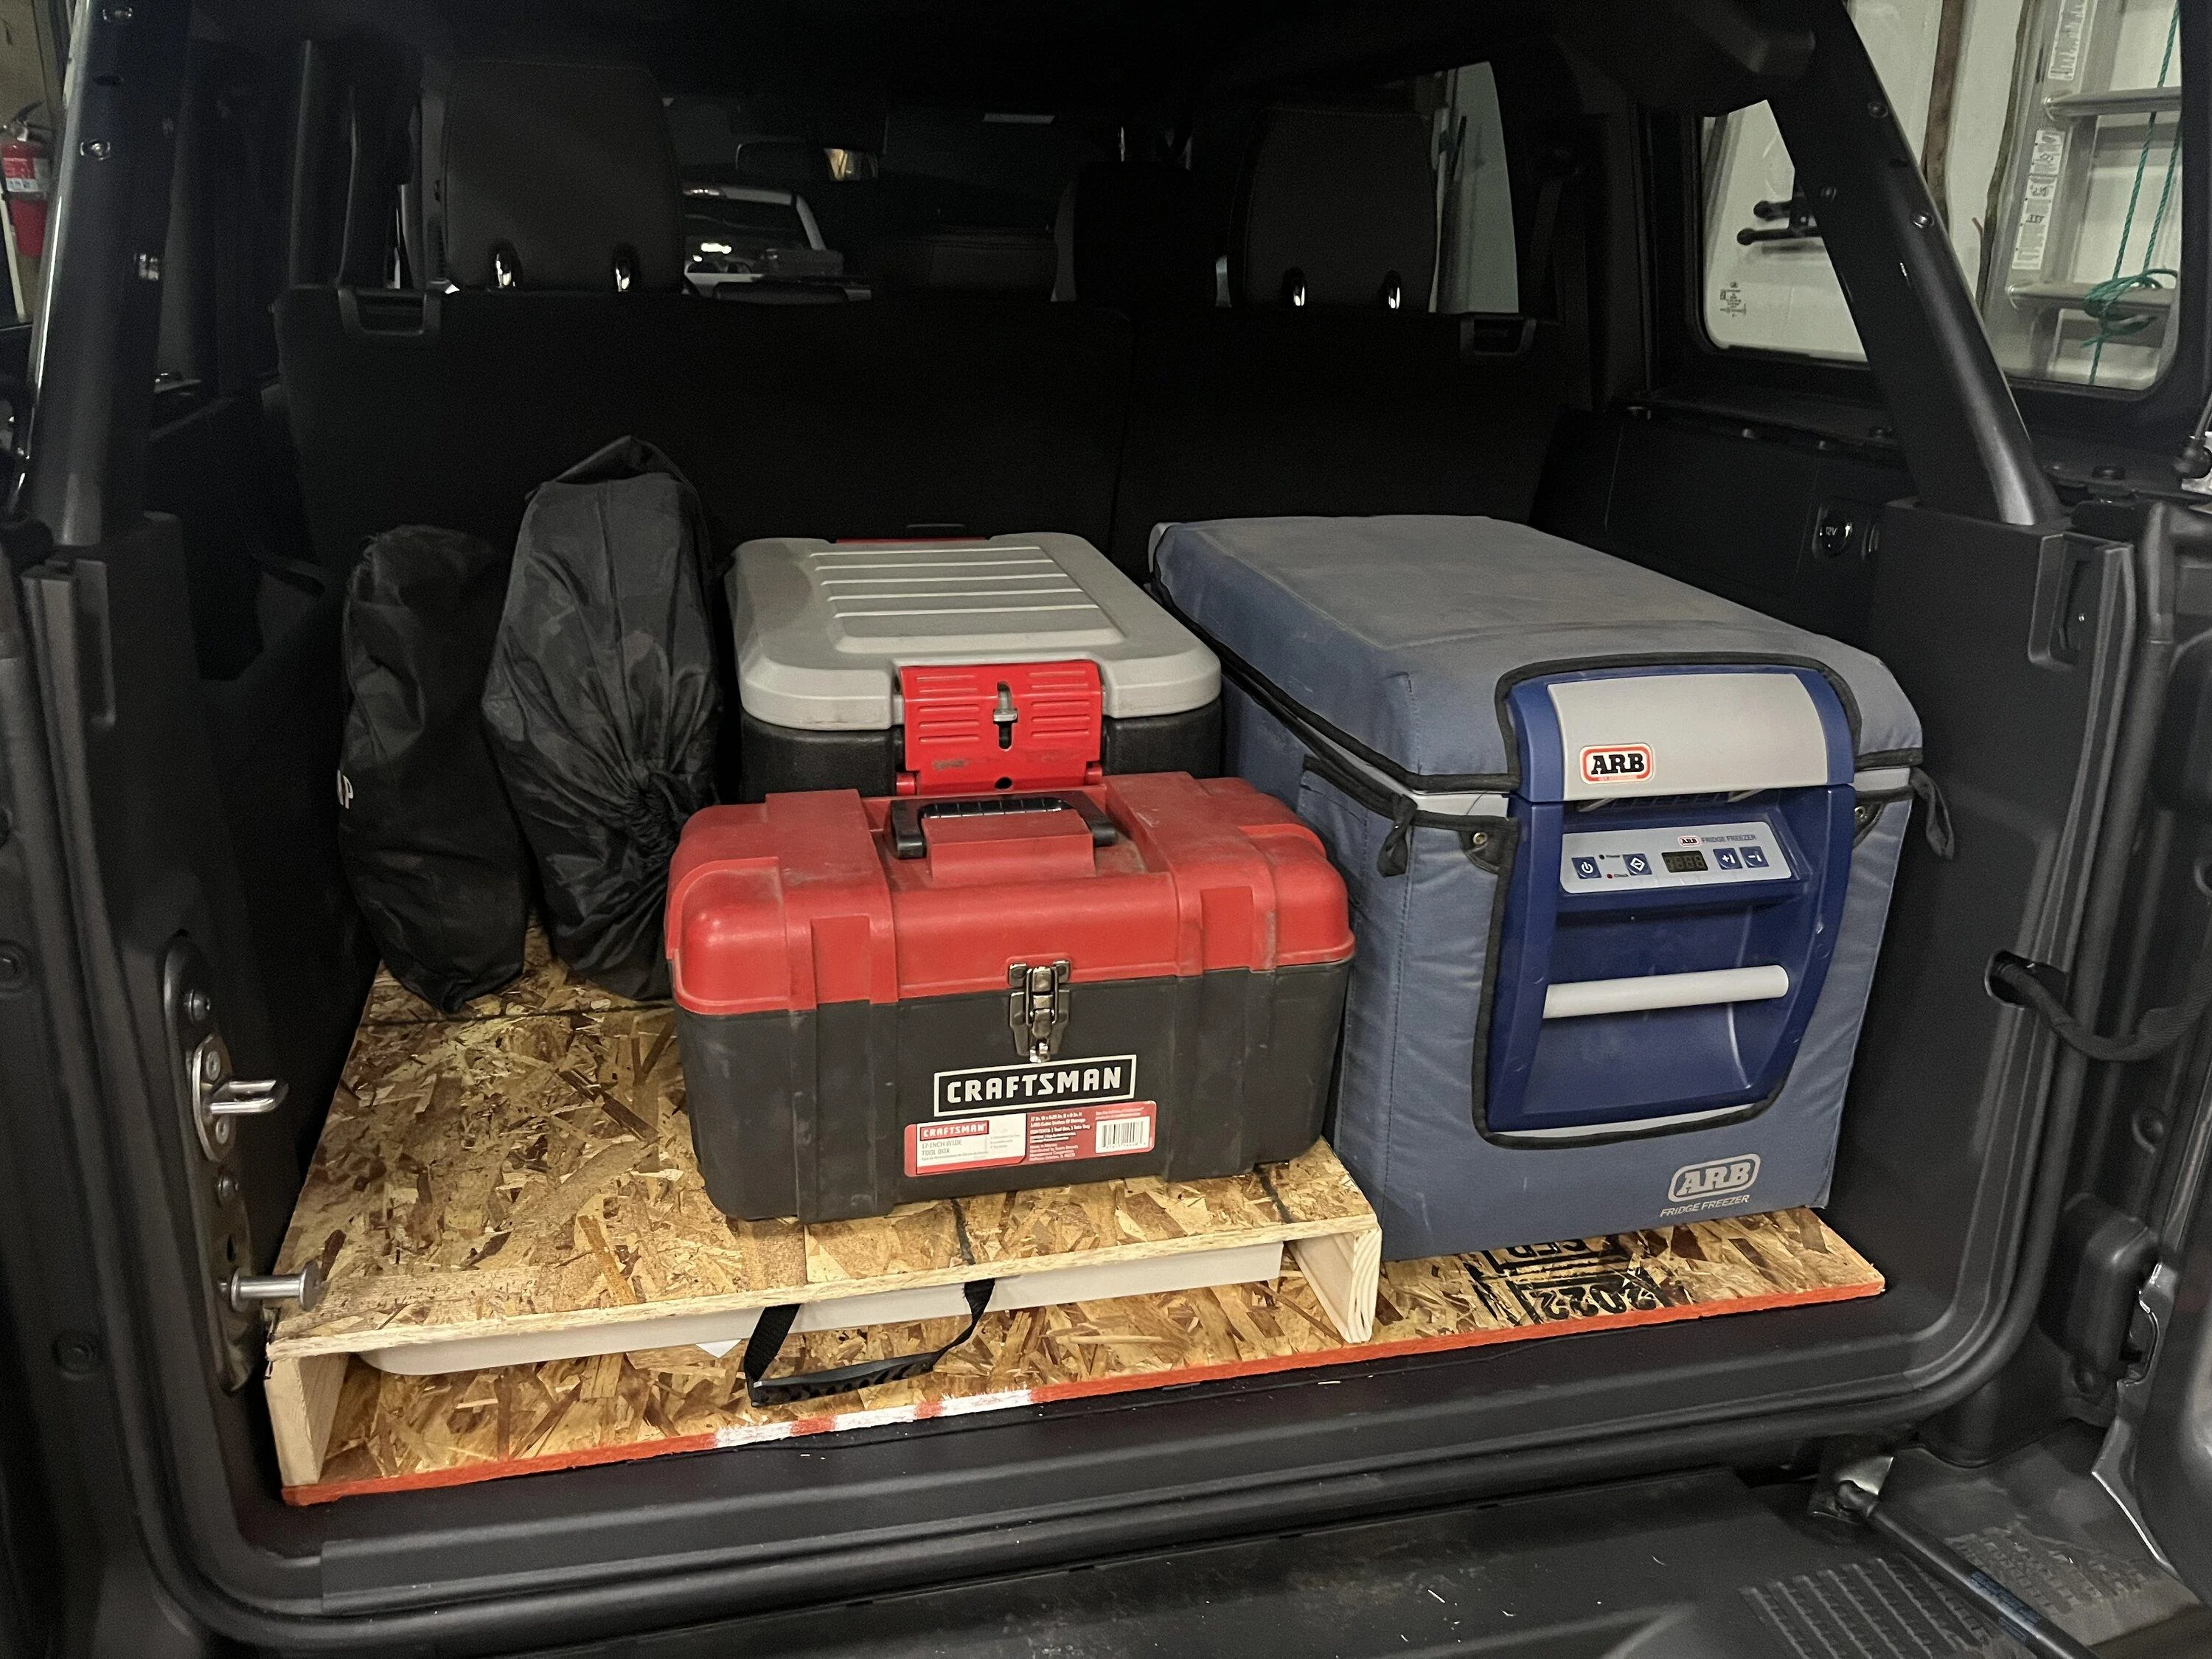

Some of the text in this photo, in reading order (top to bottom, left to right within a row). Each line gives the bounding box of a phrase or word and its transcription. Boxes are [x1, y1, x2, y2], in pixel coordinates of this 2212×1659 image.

[1590, 753, 1645, 775] ARB
[1726, 834, 1756, 842] FREEZER
[947, 1066, 1121, 1104] CRAFTSMAN
[923, 1123, 984, 1138] CRAFTSMAN
[1675, 1162, 1751, 1196] ARB
[1660, 1194, 1750, 1217] FRIDGE FREEZER
[1529, 1284, 1657, 1320] 2022
